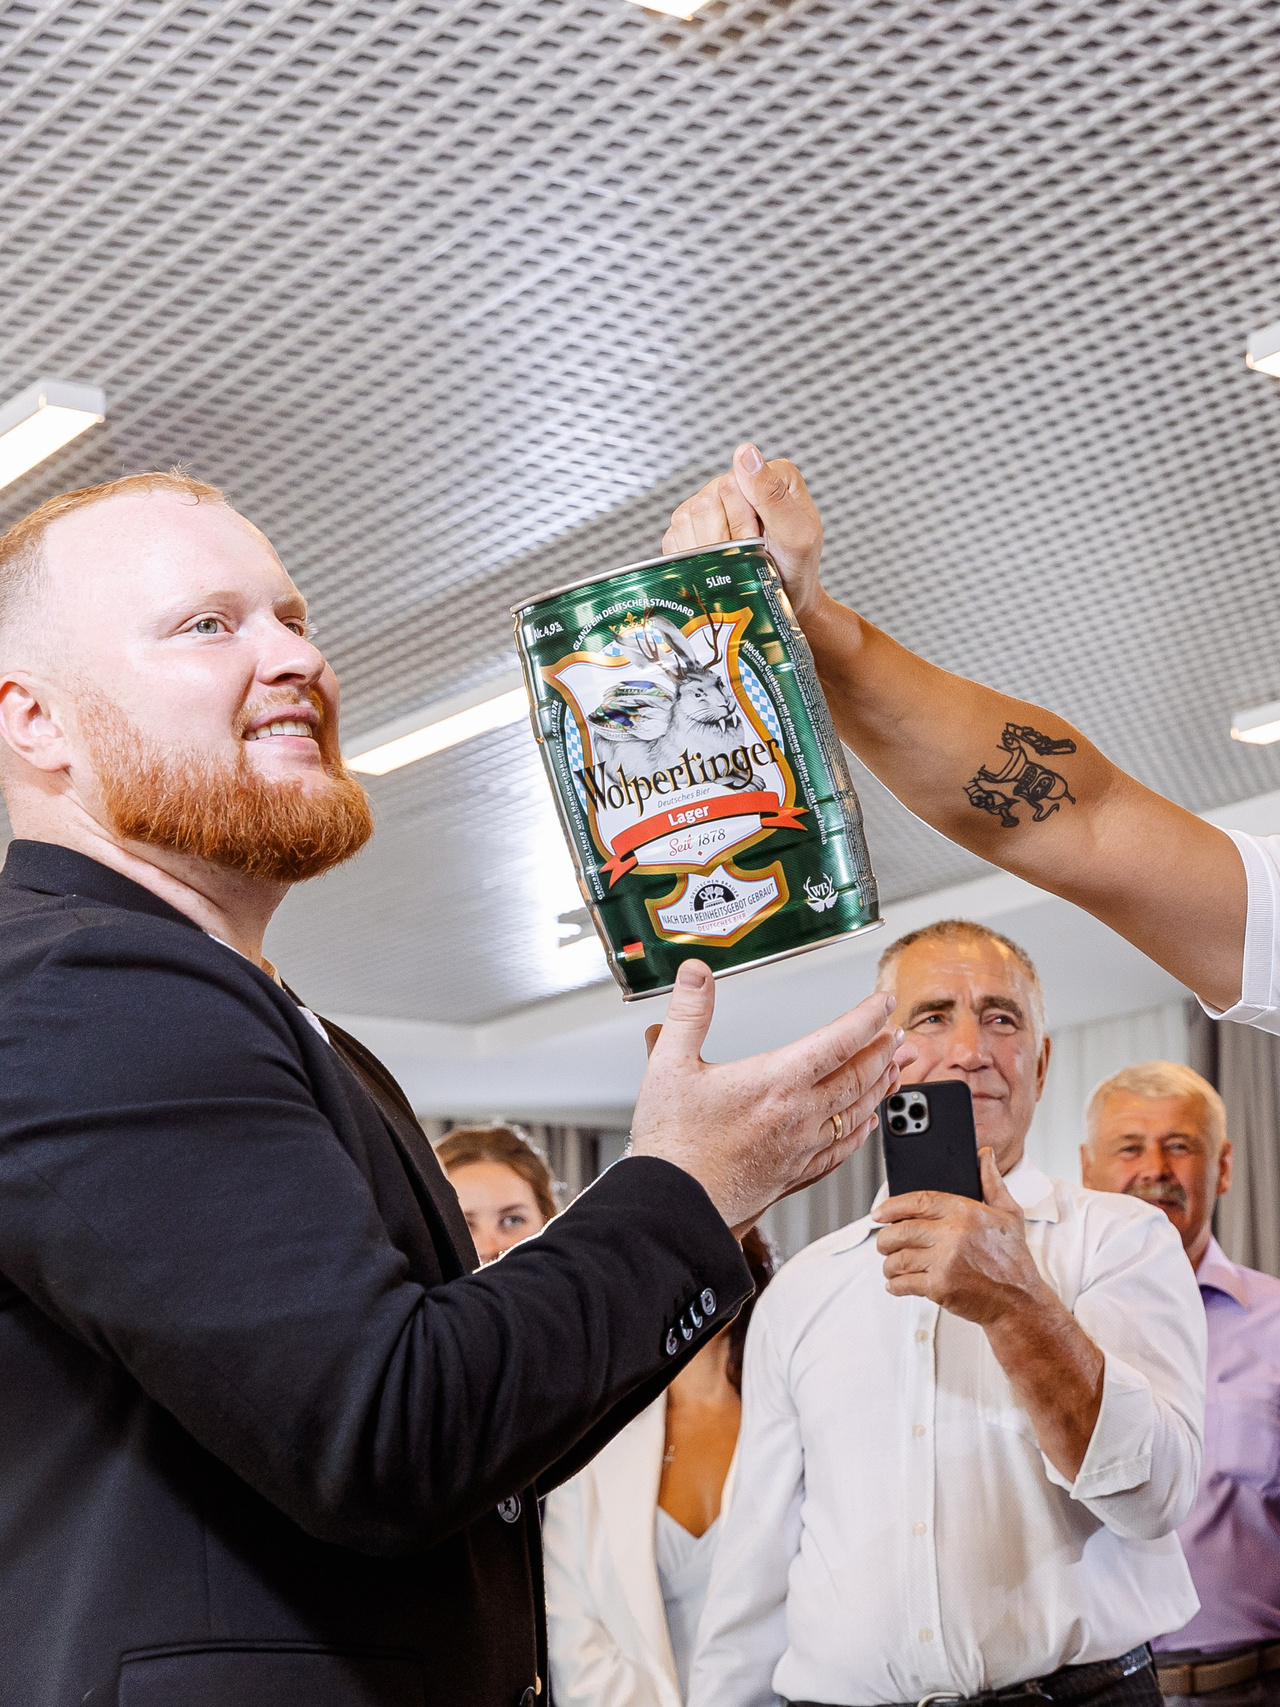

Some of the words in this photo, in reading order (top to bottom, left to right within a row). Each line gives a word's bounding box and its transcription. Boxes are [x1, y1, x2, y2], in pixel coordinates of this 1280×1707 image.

[572, 613, 603, 651] GLANZFEIN
[602, 599, 650, 619] DEUTSCHER
[650, 598, 695, 617] STANDARD
[743, 640, 767, 666] Höchste
[764, 664, 785, 704] Güteklasse
[550, 699, 558, 718] 1878
[781, 703, 790, 717] mit
[785, 717, 801, 753] erlesenen
[555, 745, 576, 812] Handwerkskunst
[573, 738, 780, 817] Wolpertinger
[797, 754, 810, 783] Zutaten
[657, 791, 695, 808] Deutsches
[695, 787, 711, 797] Bier
[807, 787, 817, 804] Echt
[573, 813, 581, 829] und
[667, 804, 709, 827] Lager
[813, 804, 822, 819] und
[578, 831, 588, 850] Herz
[669, 834, 694, 857] Seit
[697, 828, 726, 847] 1878
[817, 819, 828, 845] Ehrlich
[585, 851, 593, 865] mit
[691, 880, 719, 900] DEUTSCHEN
[721, 880, 740, 898] BRAUER
[810, 882, 829, 897] WB
[661, 914, 678, 924] NACH
[680, 913, 695, 923] DEM
[694, 899, 747, 922] REINHEITSGEBOT
[747, 883, 775, 905] GEBRAUT
[697, 919, 732, 932] DEUTSCHES
[733, 912, 747, 922] BIER
